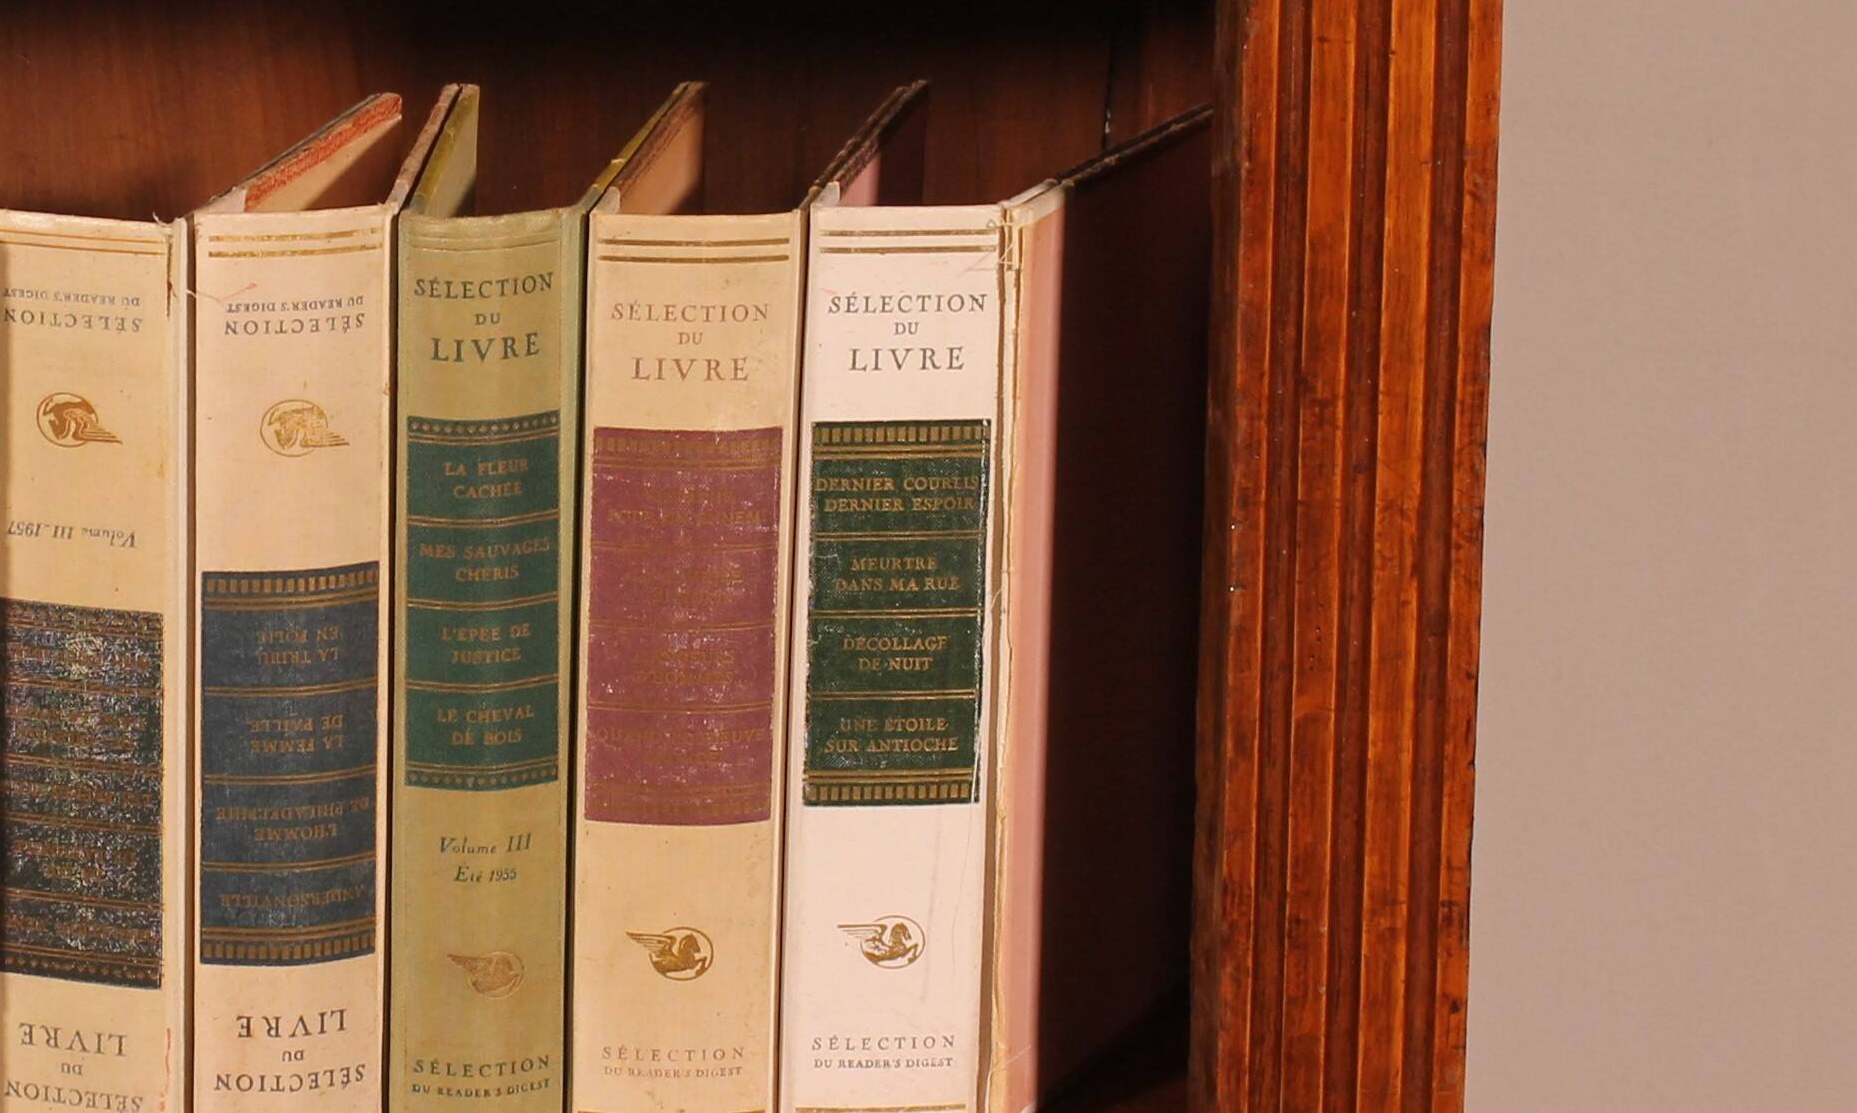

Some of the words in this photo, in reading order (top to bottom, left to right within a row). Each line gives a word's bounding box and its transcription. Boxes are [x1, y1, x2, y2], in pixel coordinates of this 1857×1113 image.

[2, 286, 49, 300] DIGEST
[413, 270, 554, 300] SÉLECTION
[52, 291, 117, 306] READER'S
[120, 295, 141, 307] DU
[280, 298, 343, 313] READER'S
[346, 295, 364, 308] DU
[827, 290, 988, 315] SÉLECTION
[225, 301, 276, 315] DIGEST
[610, 299, 770, 324] SÉLECTION
[2, 307, 144, 335] SÉLECTION
[222, 311, 365, 336] SÉLECTION
[474, 312, 502, 326] DU
[892, 320, 920, 336] DU
[430, 331, 542, 363] LIVRE
[677, 331, 704, 346] DU
[848, 345, 965, 373] LIVRE
[630, 355, 750, 382] LIVRE
[443, 460, 468, 476] LA
[477, 456, 529, 476] FLEUR
[813, 475, 896, 493] DERNIER
[902, 473, 980, 492] COURLIS
[822, 496, 905, 513] DERNIER
[910, 495, 976, 512] ESPOIR
[81, 526, 137, 549] Volume
[419, 542, 456, 560] MES
[463, 535, 551, 561] SAUVAGES
[850, 556, 939, 572] MEURTRE
[835, 577, 884, 593] DANS
[888, 577, 920, 593] MA
[923, 575, 961, 592] RUE
[316, 626, 340, 641] EN
[318, 645, 340, 662] LA
[450, 647, 523, 666] JUSTICE
[857, 657, 881, 671] DE
[887, 656, 935, 672] NUIT
[320, 713, 345, 729] DE
[435, 707, 459, 724] LE
[464, 703, 535, 725] CHEVAL
[250, 717, 314, 733] PAILLE
[840, 717, 879, 733] UNE
[322, 733, 343, 749] LA
[481, 727, 523, 745] BOIS
[249, 738, 316, 753] FEMME
[823, 739, 859, 755] SUR
[866, 737, 959, 753] ANTIOCHE
[438, 835, 498, 855] Volume
[505, 832, 533, 853] III
[487, 867, 518, 883] 1955
[235, 1007, 348, 1039] LIVRE
[17, 1021, 128, 1057] LIVRE
[811, 1033, 957, 1052] SÉLECTION
[281, 1049, 306, 1062] DU
[601, 1043, 745, 1064] SÉLECTION
[60, 1062, 84, 1077] DU
[412, 1054, 551, 1079] SÉLECTION
[813, 1058, 833, 1070] DU
[837, 1057, 902, 1070] READER'S
[905, 1056, 954, 1069] DIGEST
[213, 1063, 366, 1093] SÉLECTION
[603, 1065, 623, 1077] DU
[626, 1066, 692, 1080] READER'S
[694, 1065, 743, 1079] DIGEST
[3, 1079, 144, 1113] SÉLECTION
[410, 1082, 431, 1095] DU
[505, 1077, 551, 1097] DIGEST
